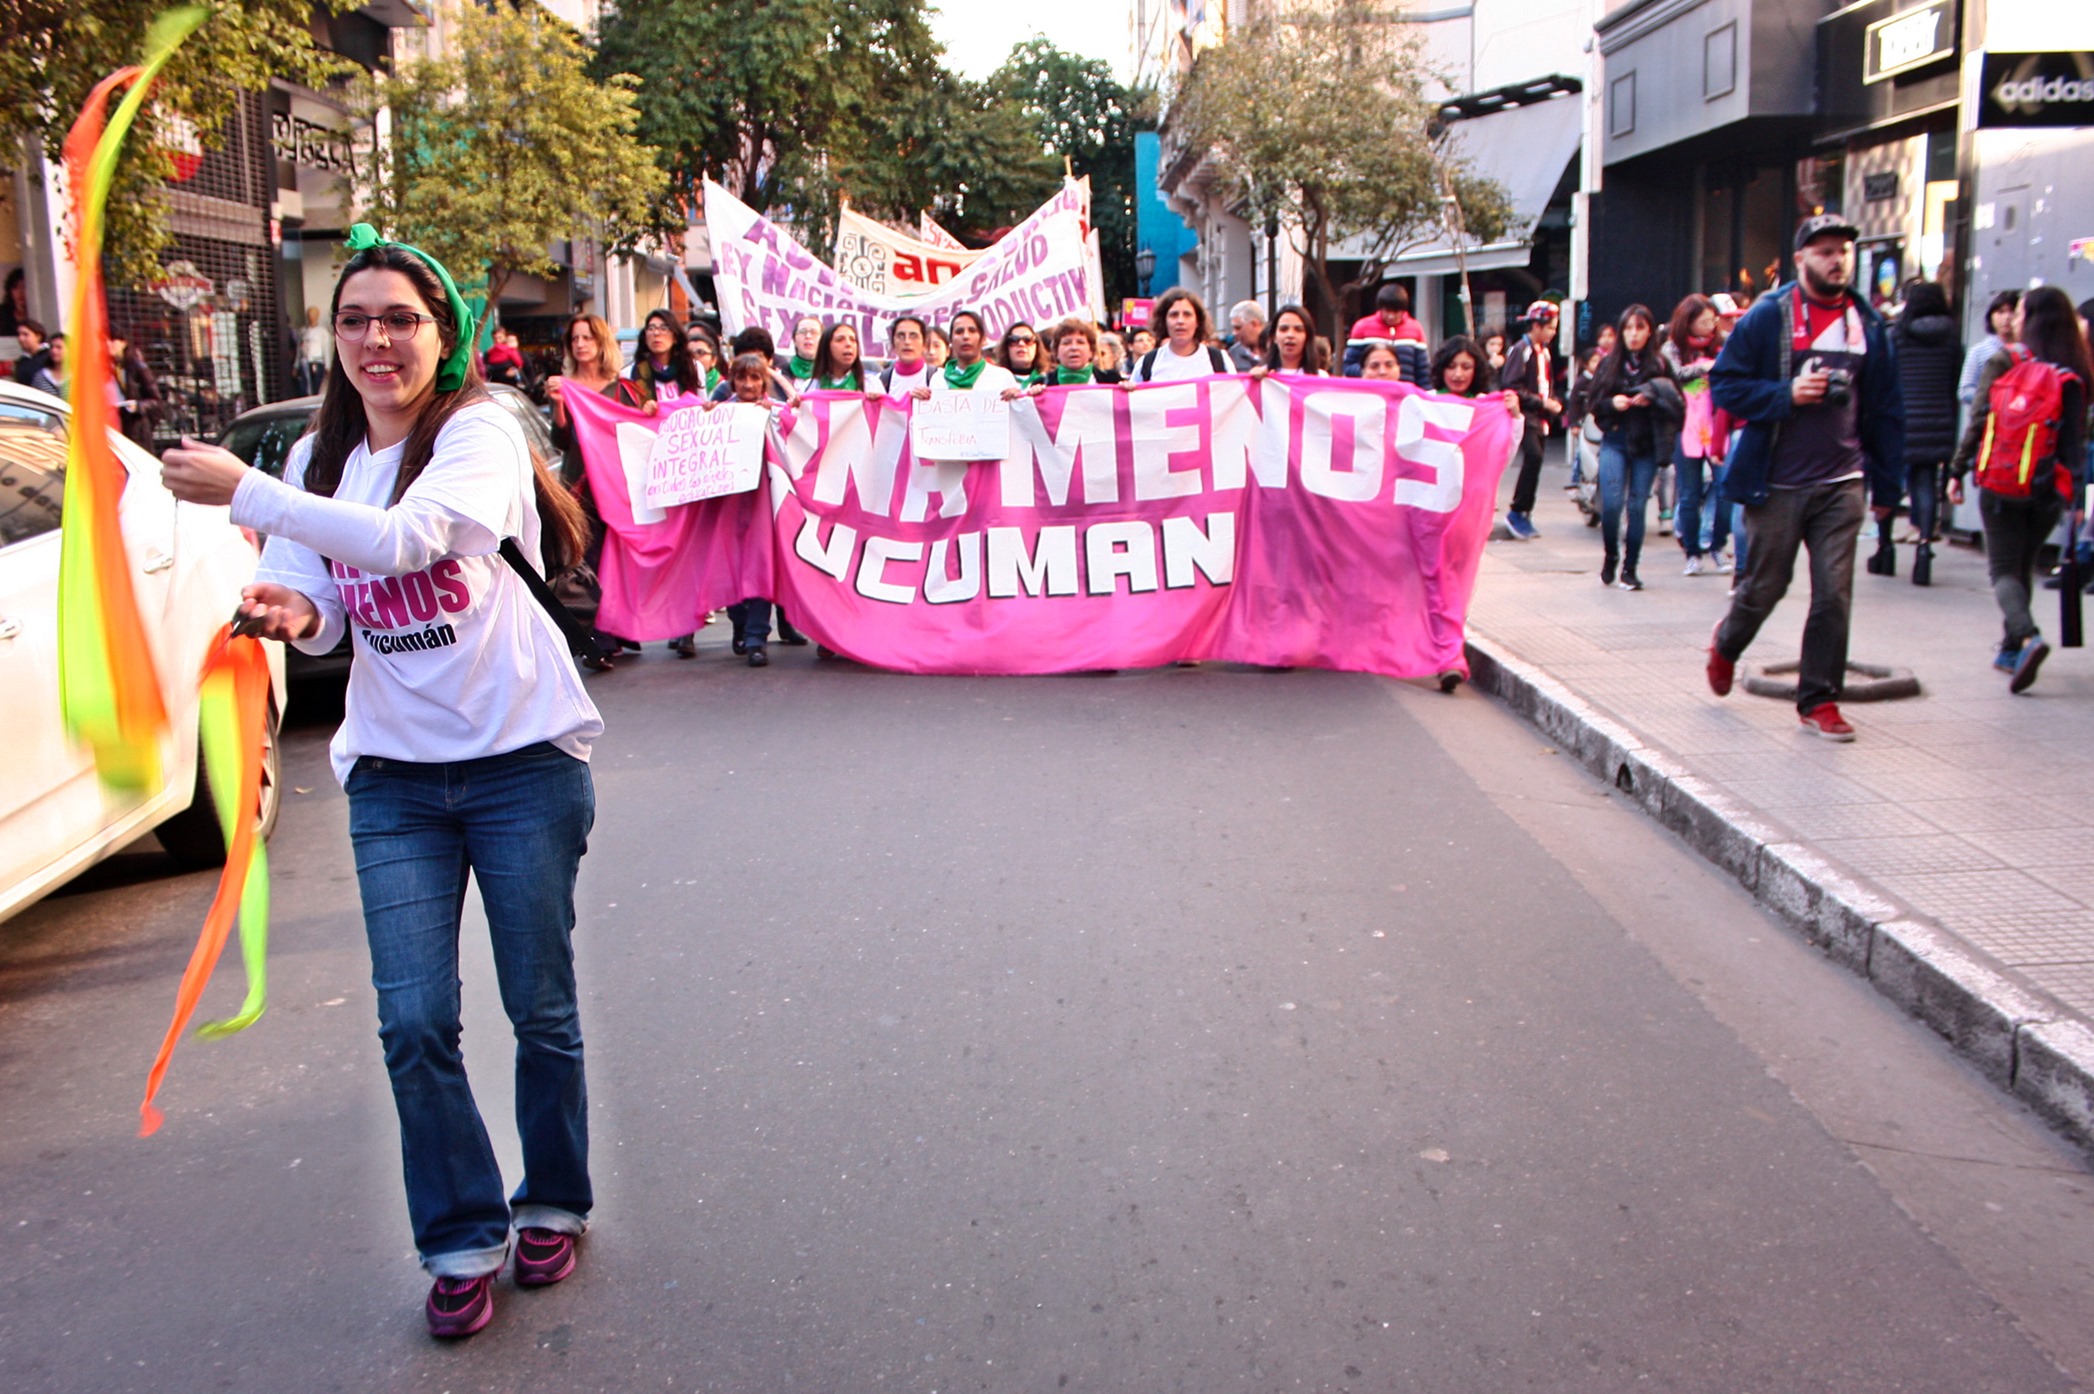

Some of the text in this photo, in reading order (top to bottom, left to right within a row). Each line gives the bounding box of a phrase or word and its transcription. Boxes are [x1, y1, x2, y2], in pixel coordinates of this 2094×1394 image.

[2000, 75, 2094, 102] adidas
[967, 234, 1048, 304] SALUD
[918, 394, 1003, 415] BASTA DE
[667, 424, 740, 454] SEXUAL
[1000, 378, 1475, 513] MENOS
[335, 558, 470, 630] MENOS
[361, 623, 457, 655] Tucumán
